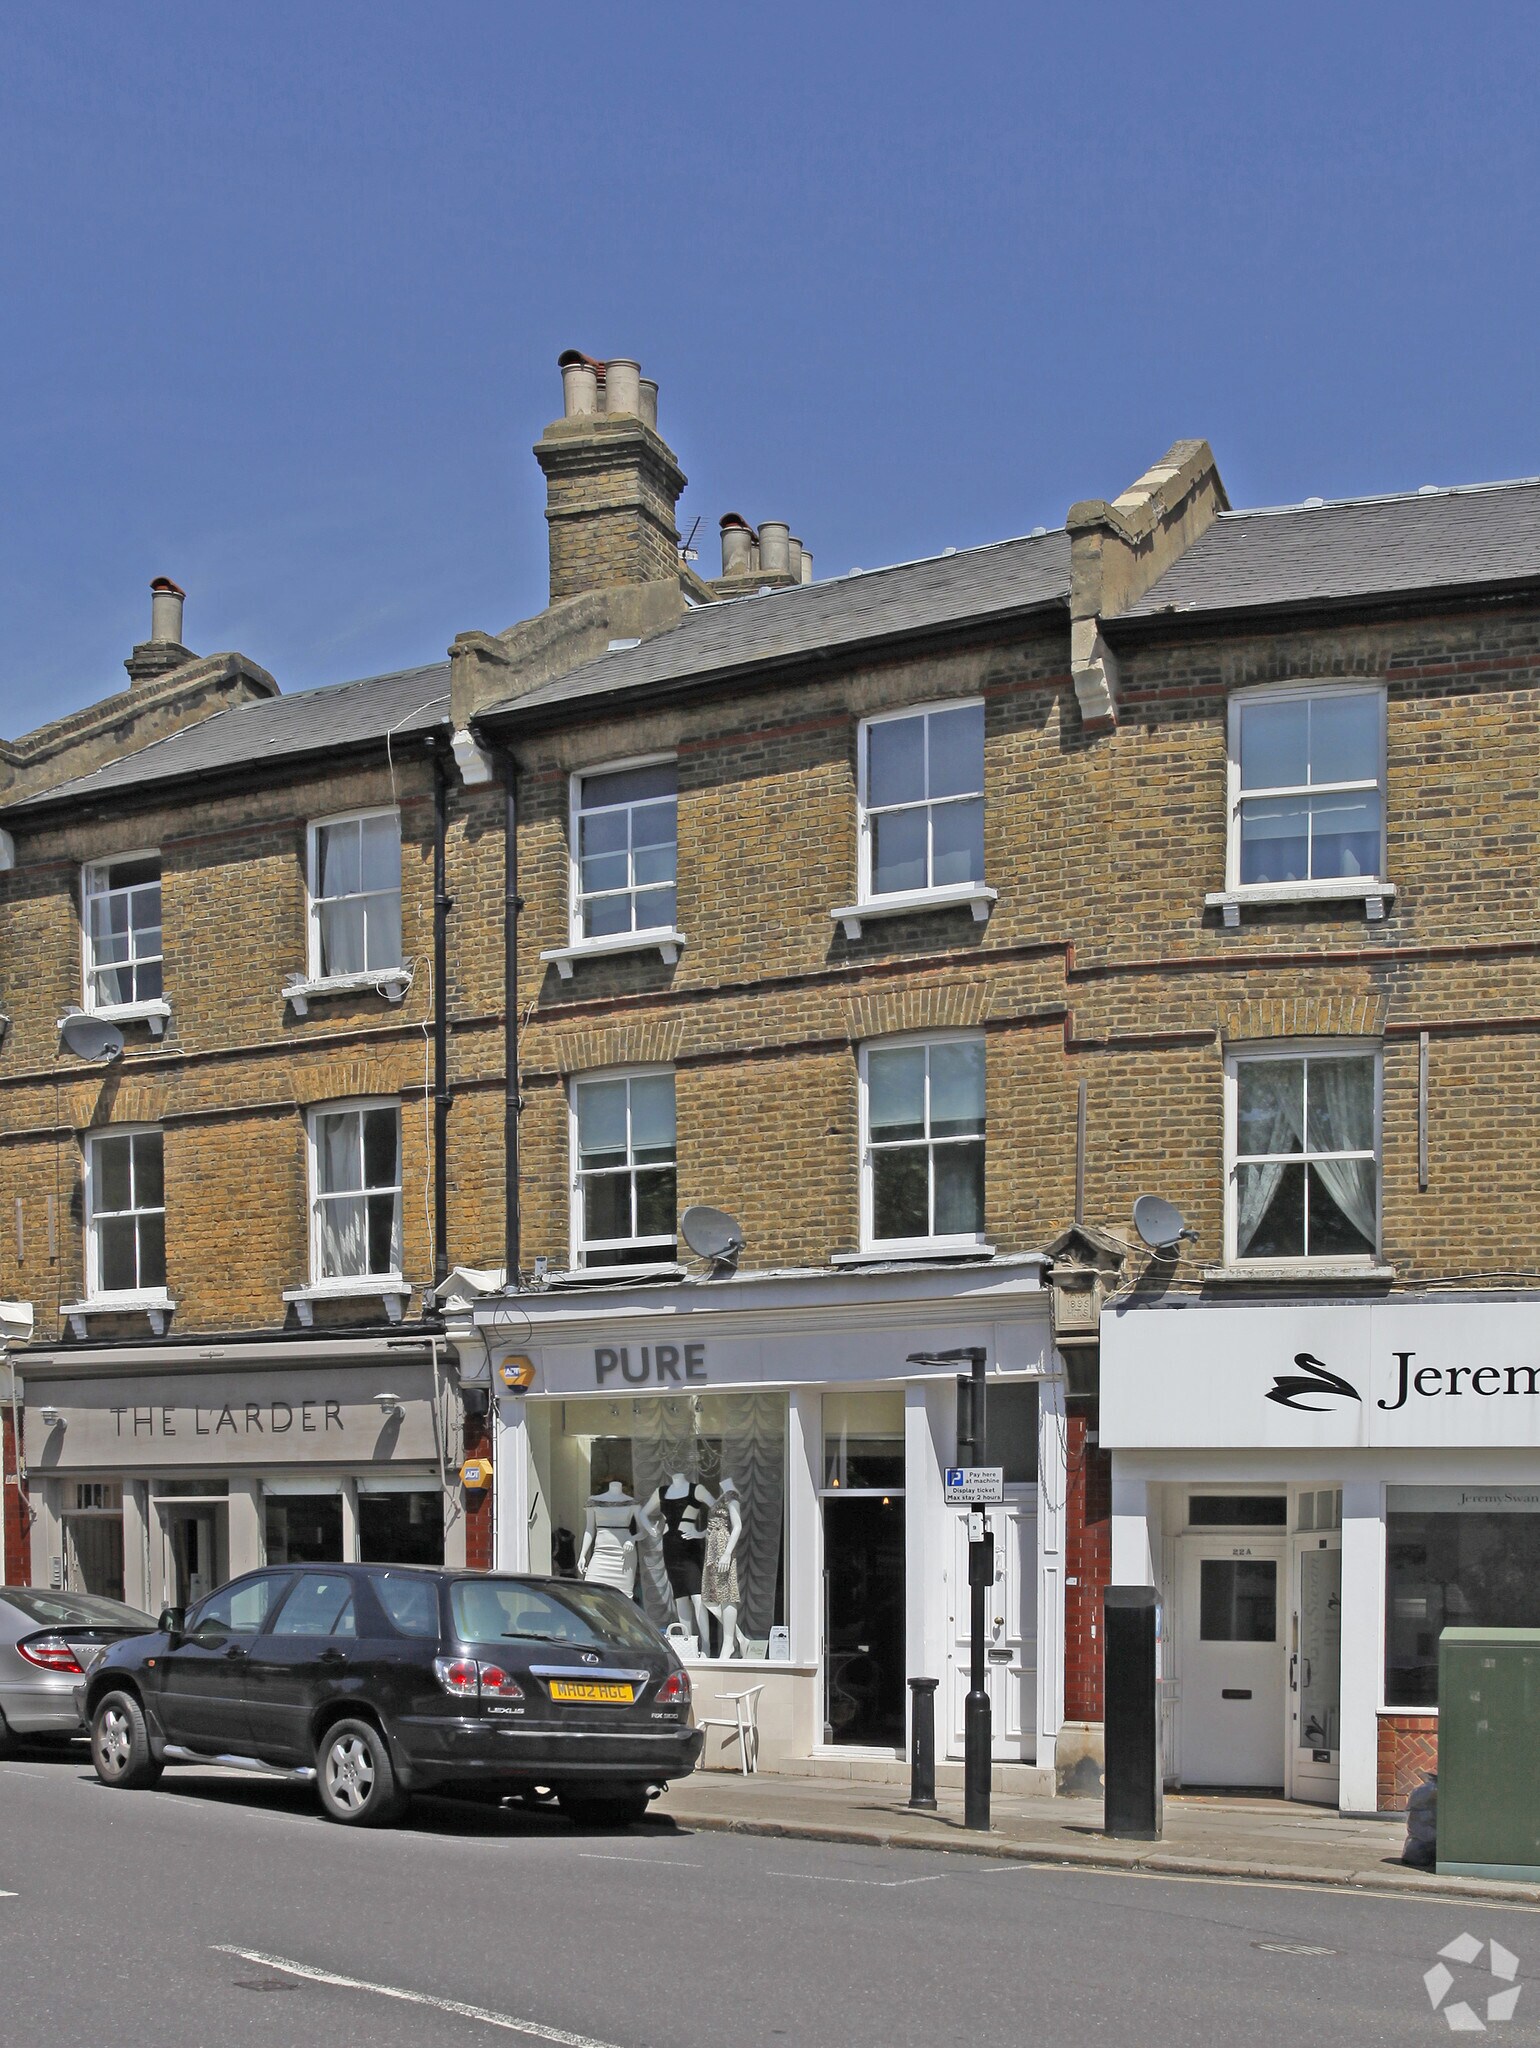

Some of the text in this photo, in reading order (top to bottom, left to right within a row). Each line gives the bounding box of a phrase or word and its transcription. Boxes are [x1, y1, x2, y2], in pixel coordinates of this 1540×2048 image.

[594, 1344, 708, 1384] PURE
[504, 1367, 520, 1376] ADT
[1377, 1352, 1540, 1410] Jerem
[110, 1405, 176, 1436] THE
[465, 1470, 480, 1479] ADT
[1232, 1548, 1252, 1556] 22A
[487, 1707, 525, 1715] LEXUS
